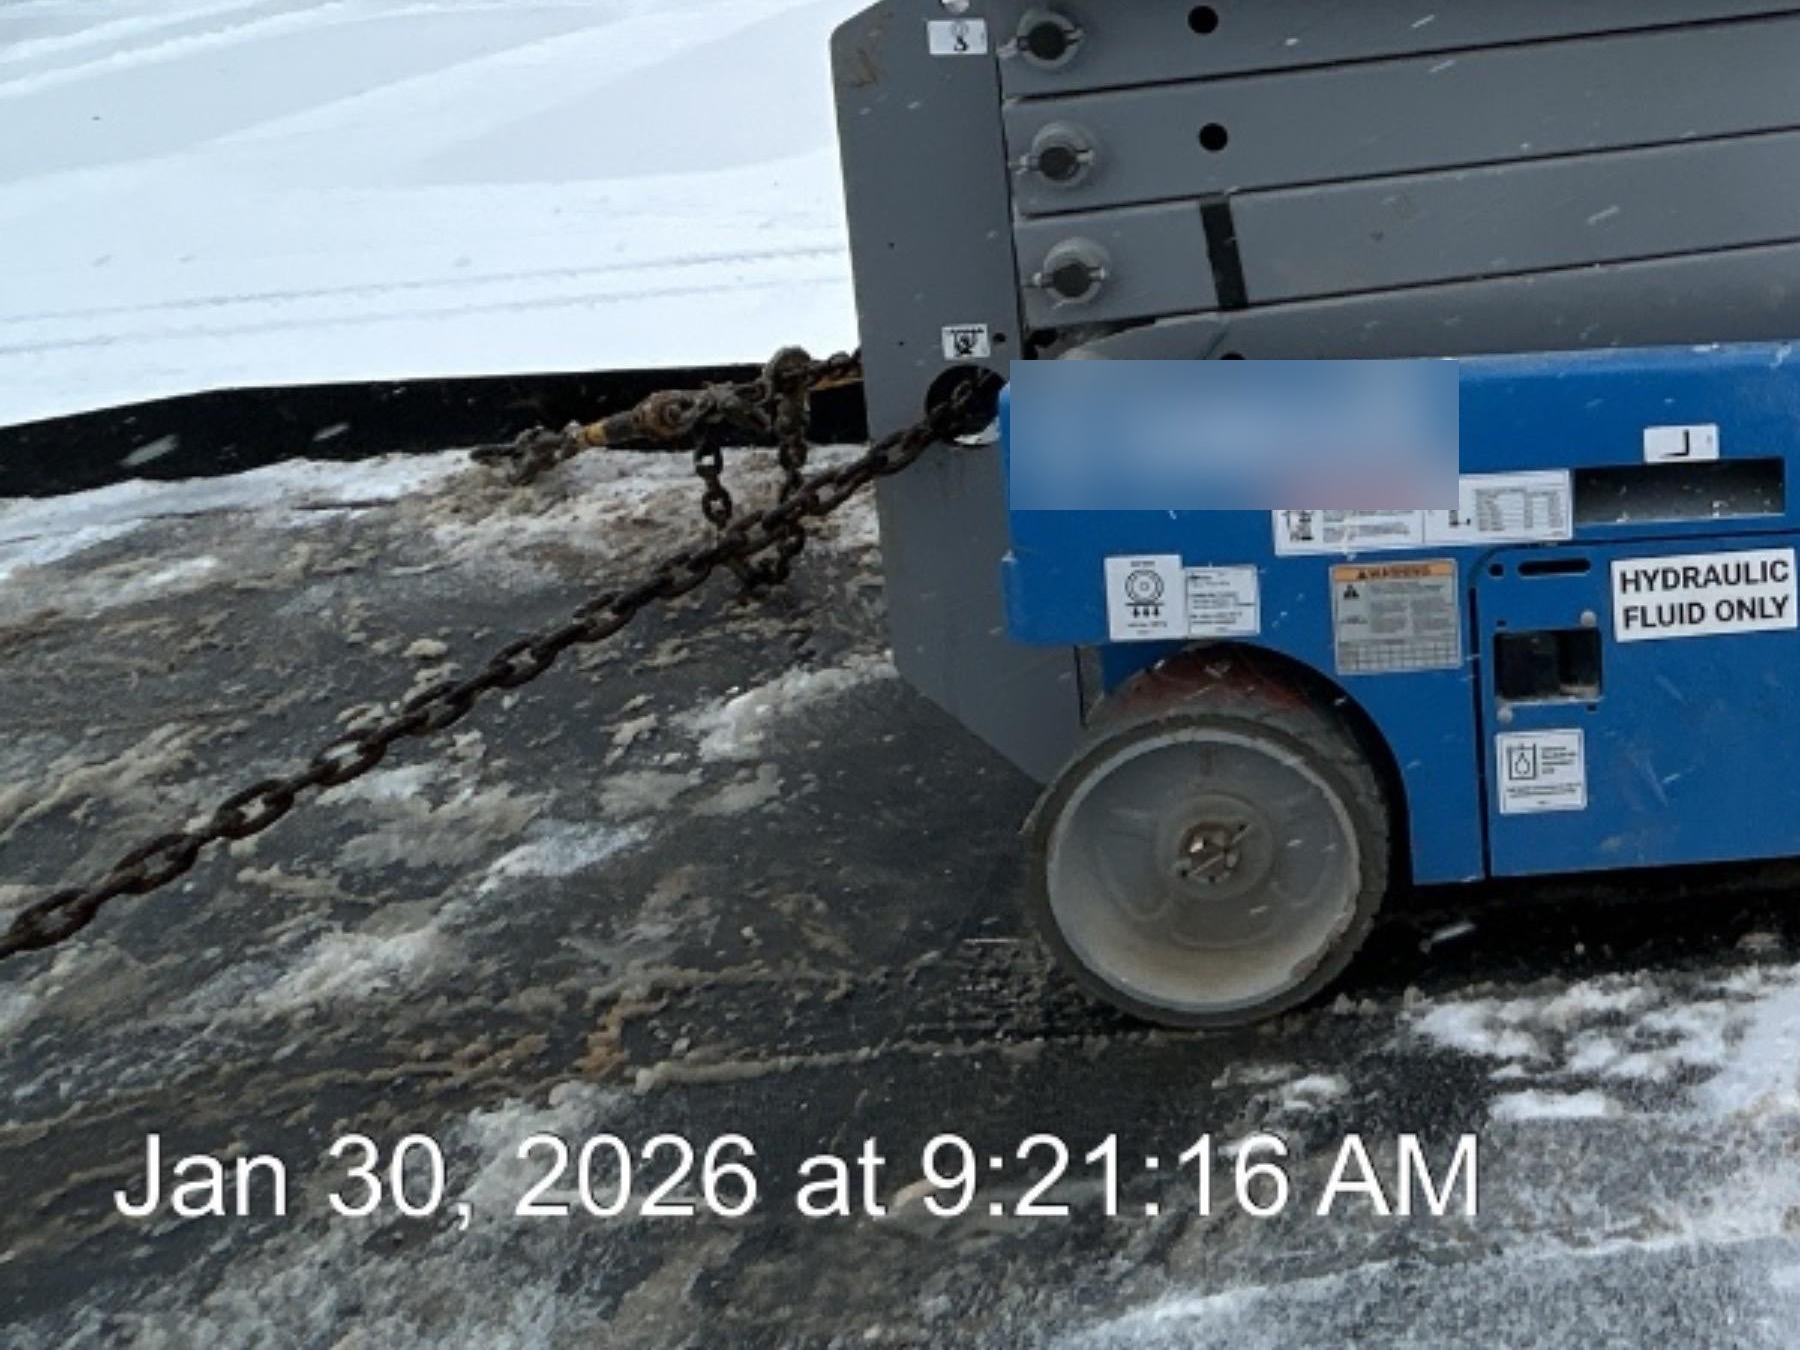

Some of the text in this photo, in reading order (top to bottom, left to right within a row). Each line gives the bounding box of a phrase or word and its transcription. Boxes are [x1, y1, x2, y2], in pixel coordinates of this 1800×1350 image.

[1619, 559, 1790, 595] HYDRAULIC
[1622, 595, 1790, 631] FLUID ONLY
